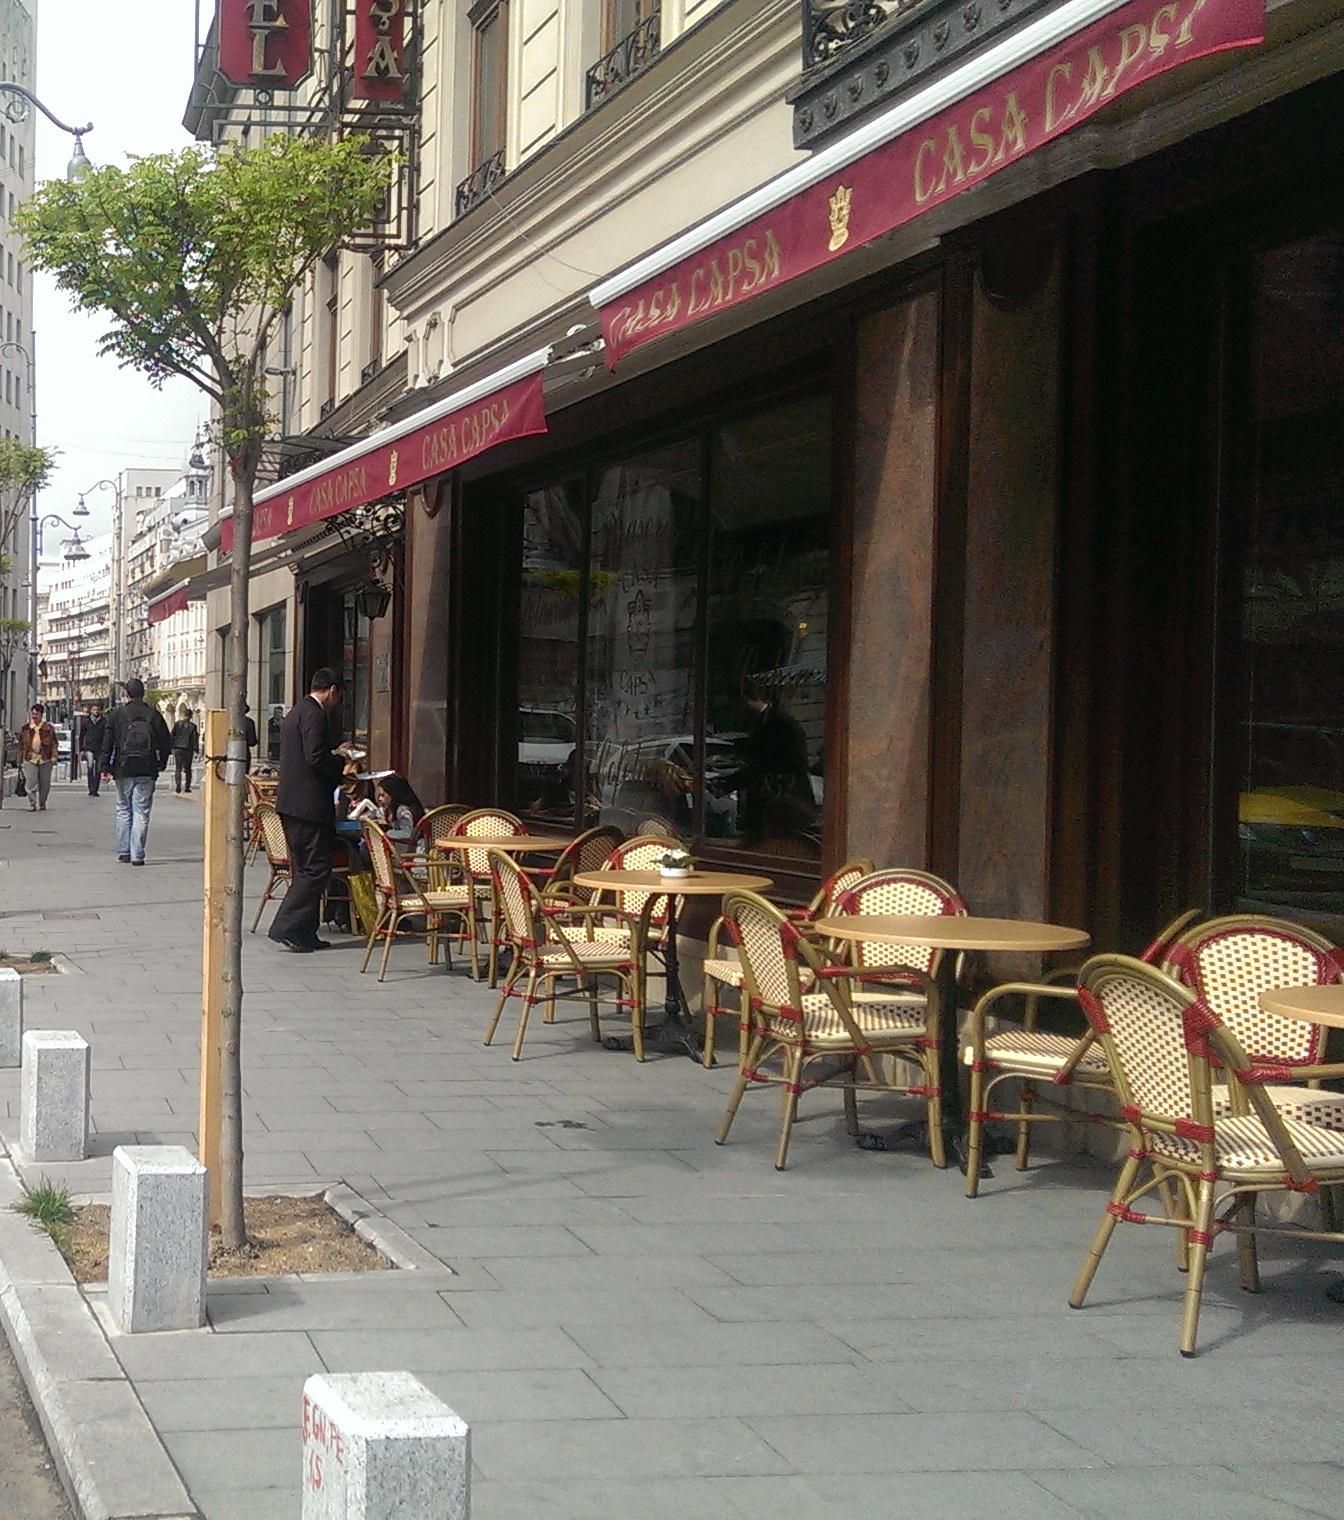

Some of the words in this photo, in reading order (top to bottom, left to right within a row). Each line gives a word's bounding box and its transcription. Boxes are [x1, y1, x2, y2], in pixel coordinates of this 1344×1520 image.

[913, 91, 1028, 206] CASA
[609, 283, 681, 348] CASA
[687, 229, 782, 316] CAPSA
[422, 423, 458, 471] CASA
